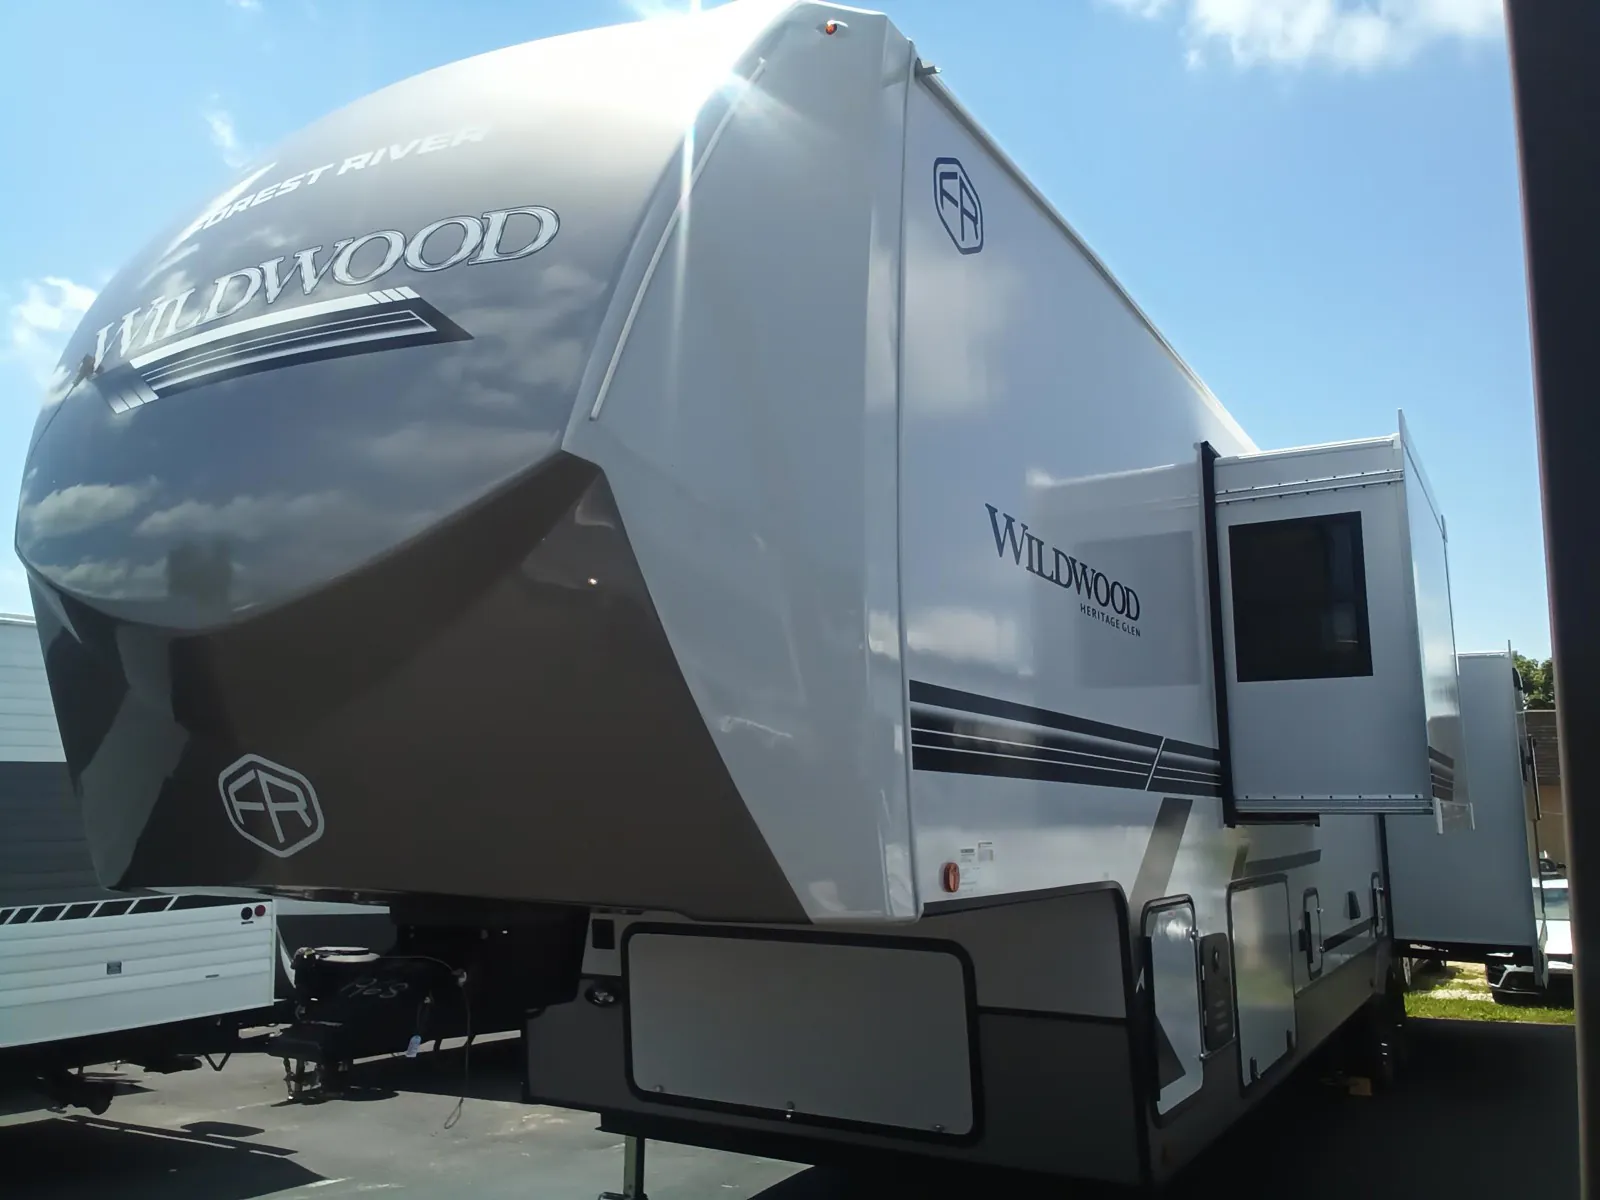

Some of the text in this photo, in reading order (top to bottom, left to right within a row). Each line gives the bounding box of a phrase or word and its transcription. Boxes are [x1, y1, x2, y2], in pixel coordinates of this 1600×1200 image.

[336, 127, 487, 176] RIVER
[92, 205, 560, 375] WILDWOOD
[985, 503, 1140, 621] WILDWOOD
[1080, 602, 1141, 637] HERITAGE GLEN
